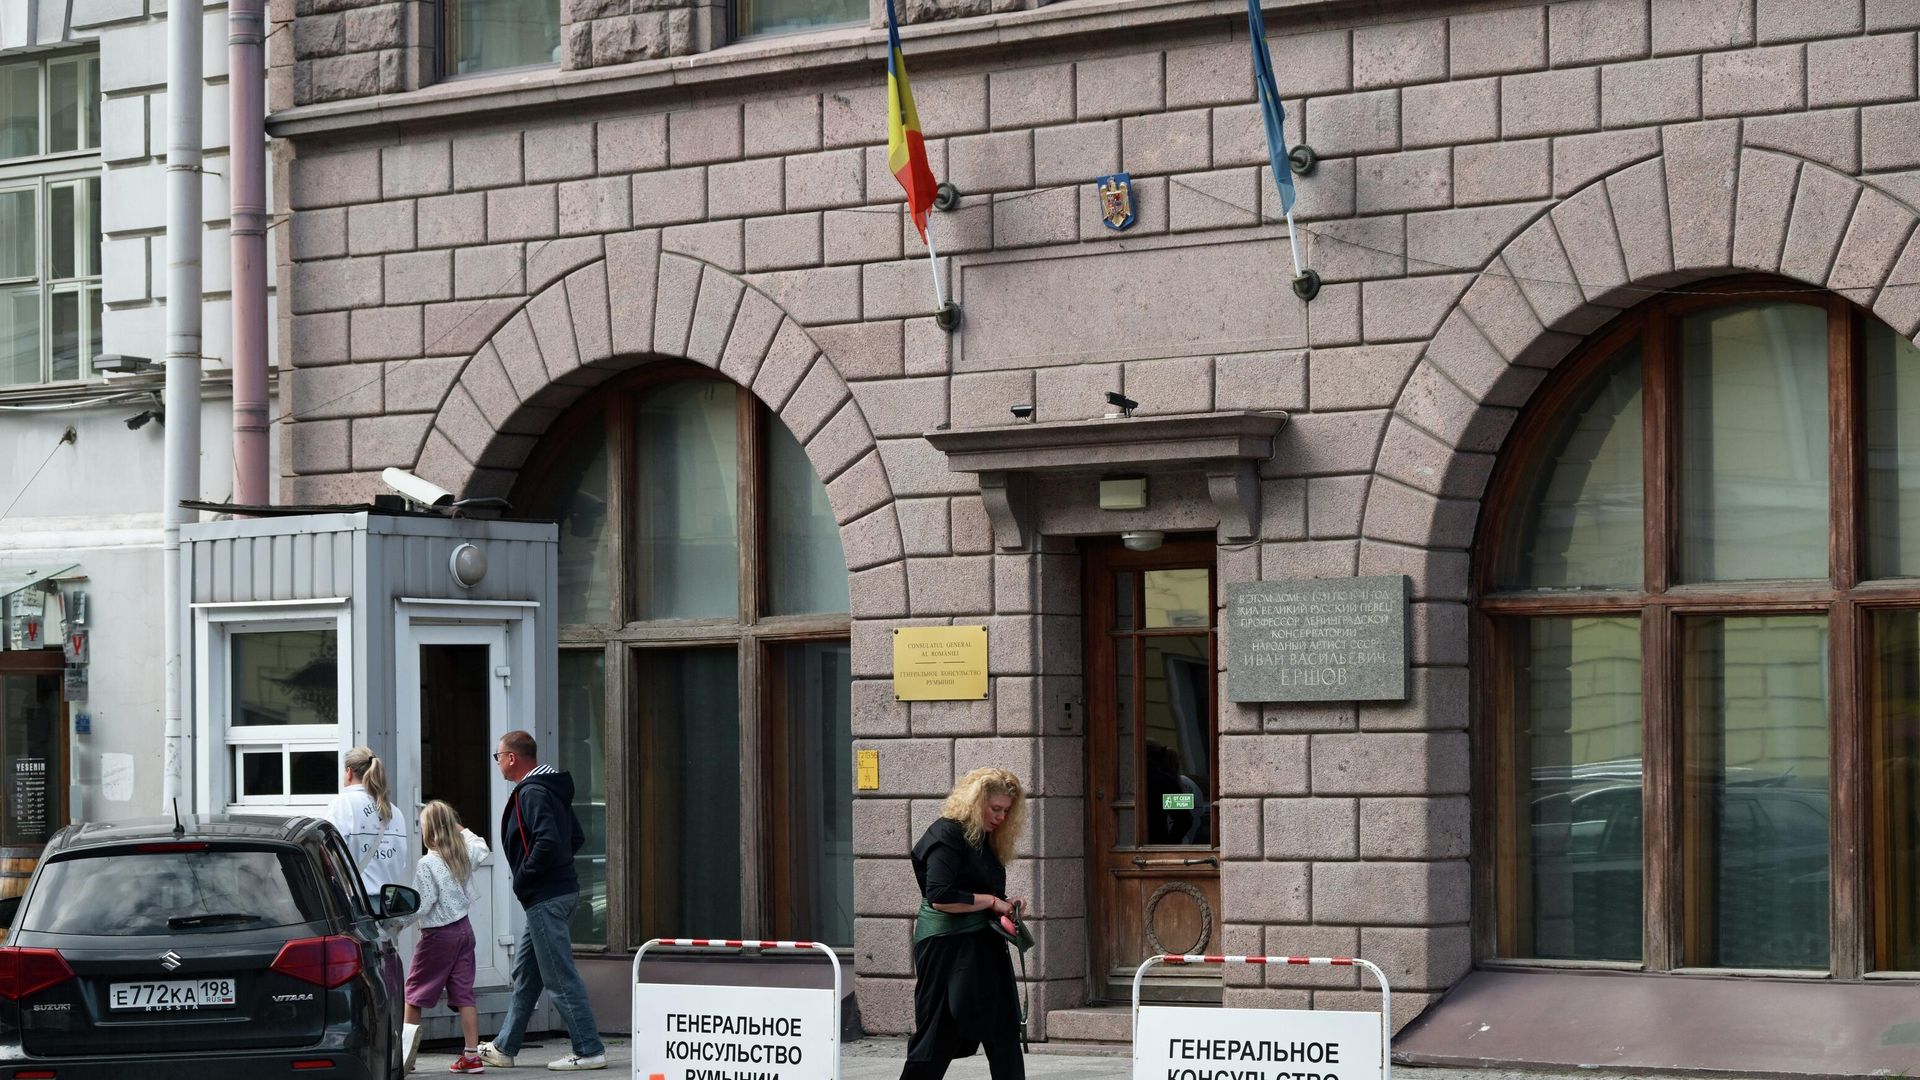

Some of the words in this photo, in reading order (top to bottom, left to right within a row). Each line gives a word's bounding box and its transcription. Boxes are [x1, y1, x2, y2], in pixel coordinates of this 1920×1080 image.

[1262, 604, 1308, 615] ВЕЛИКИЙ
[1240, 616, 1300, 627] ПРОФЕССОР
[1271, 628, 1358, 639] КОНСЕРВАТОРИИ
[1252, 640, 1306, 651] НАРОДНЫЙ
[1309, 639, 1347, 650] АРТИСТ
[1244, 653, 1284, 666] ИВАН
[1290, 651, 1386, 666] ВАСИЛЬЕВИЧ
[1281, 667, 1347, 686] ЕРШОВ
[16, 762, 46, 772] YESENIN
[361, 843, 397, 860] SASO
[200, 981, 230, 997] 198
[271, 993, 314, 1002] VITARA
[33, 1003, 71, 1012] SUZUKI
[145, 1003, 199, 1012] RUSSIA
[666, 1013, 802, 1038] ГЕНЕРАЛЬНОЕ
[665, 1040, 803, 1066] КОНСУЛЬСТВО
[1169, 1038, 1340, 1064] ГЕНЕРАЛЬНОЕ
